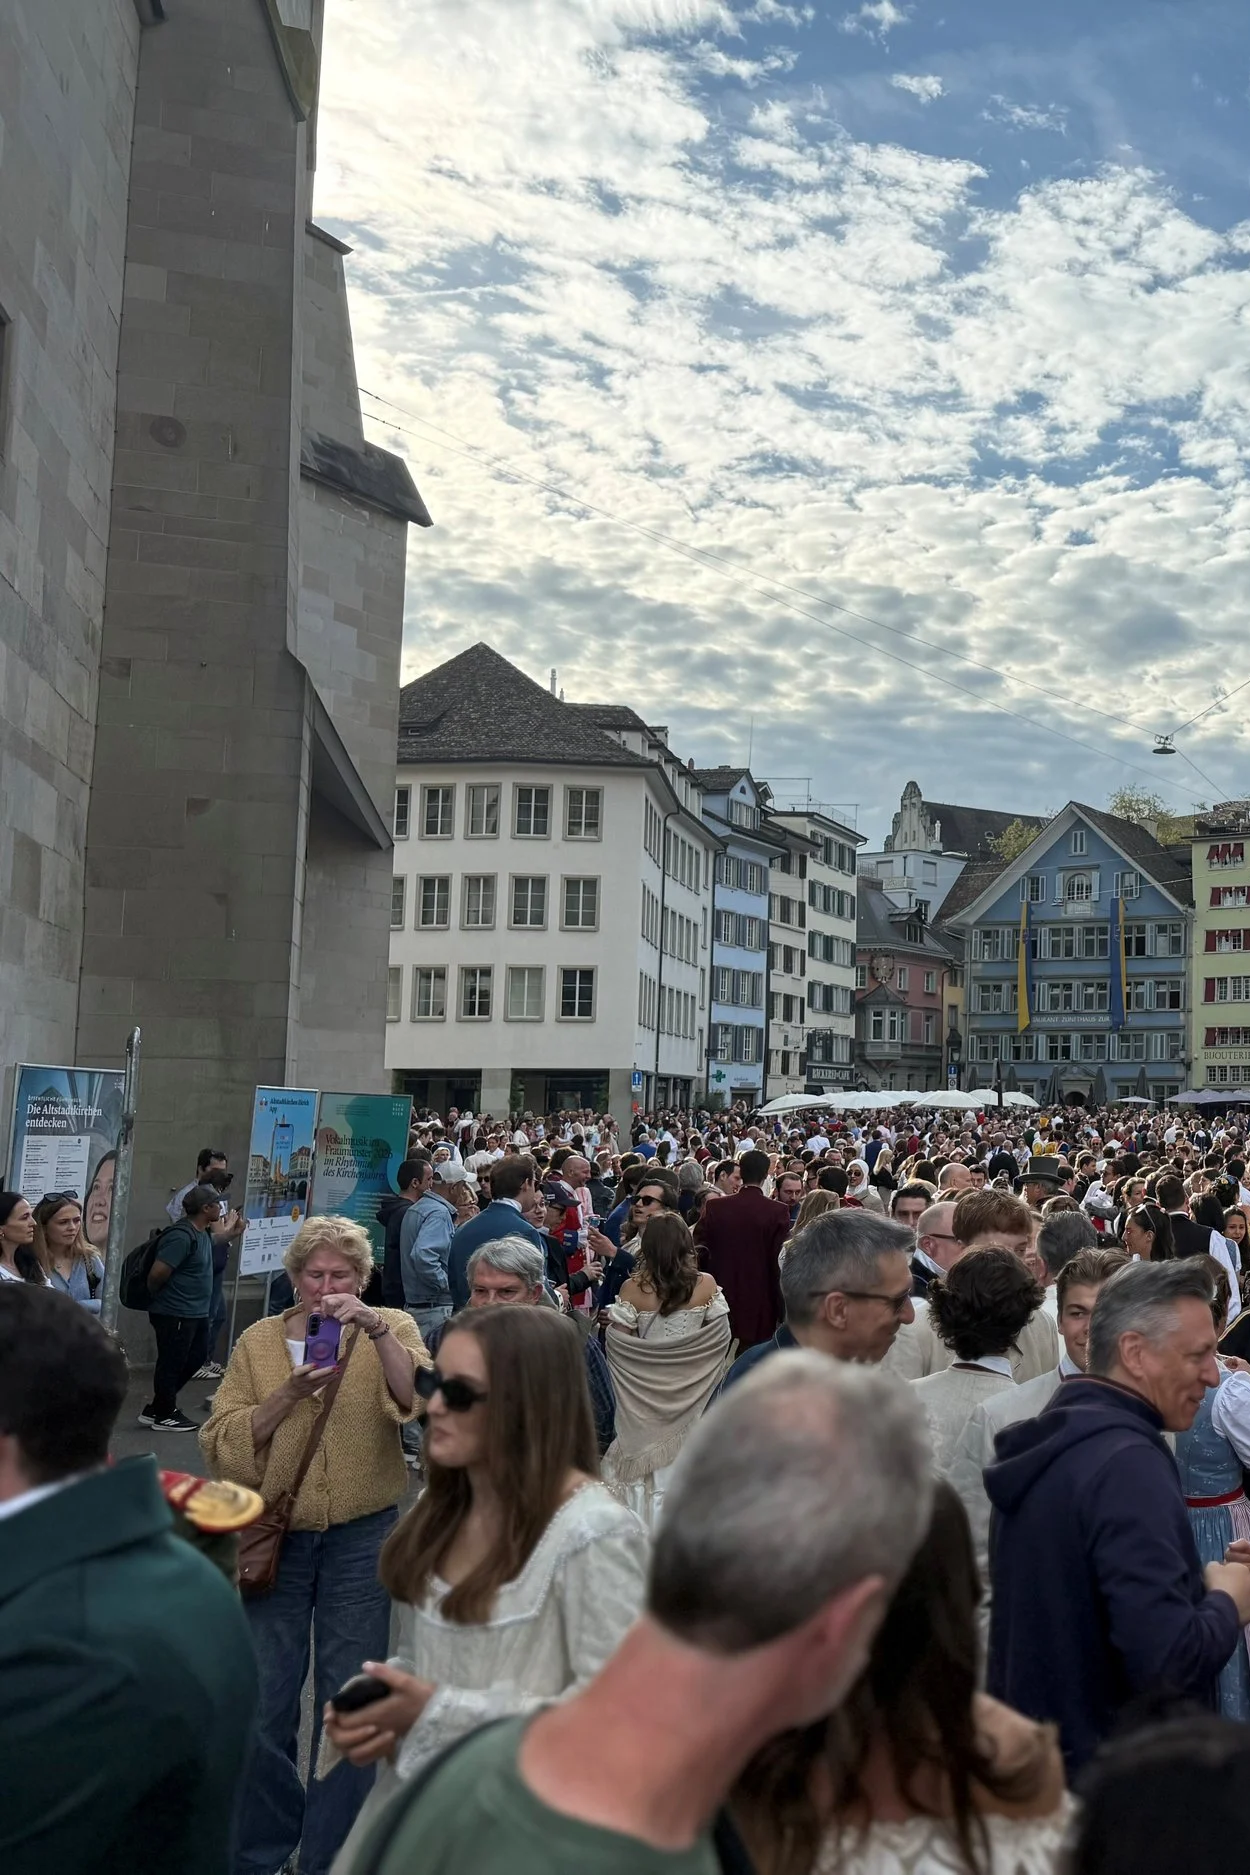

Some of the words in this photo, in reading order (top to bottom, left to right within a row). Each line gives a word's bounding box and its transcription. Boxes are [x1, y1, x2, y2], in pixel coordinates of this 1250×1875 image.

[27, 1104, 41, 1114] Die
[42, 1104, 102, 1116] Altstadtkirchen
[25, 1117, 67, 1128] entdecken
[325, 1134, 368, 1146] Vokalmusik
[325, 1145, 372, 1157] Fraumünster
[324, 1156, 333, 1166] im
[323, 1167, 335, 1177] des
